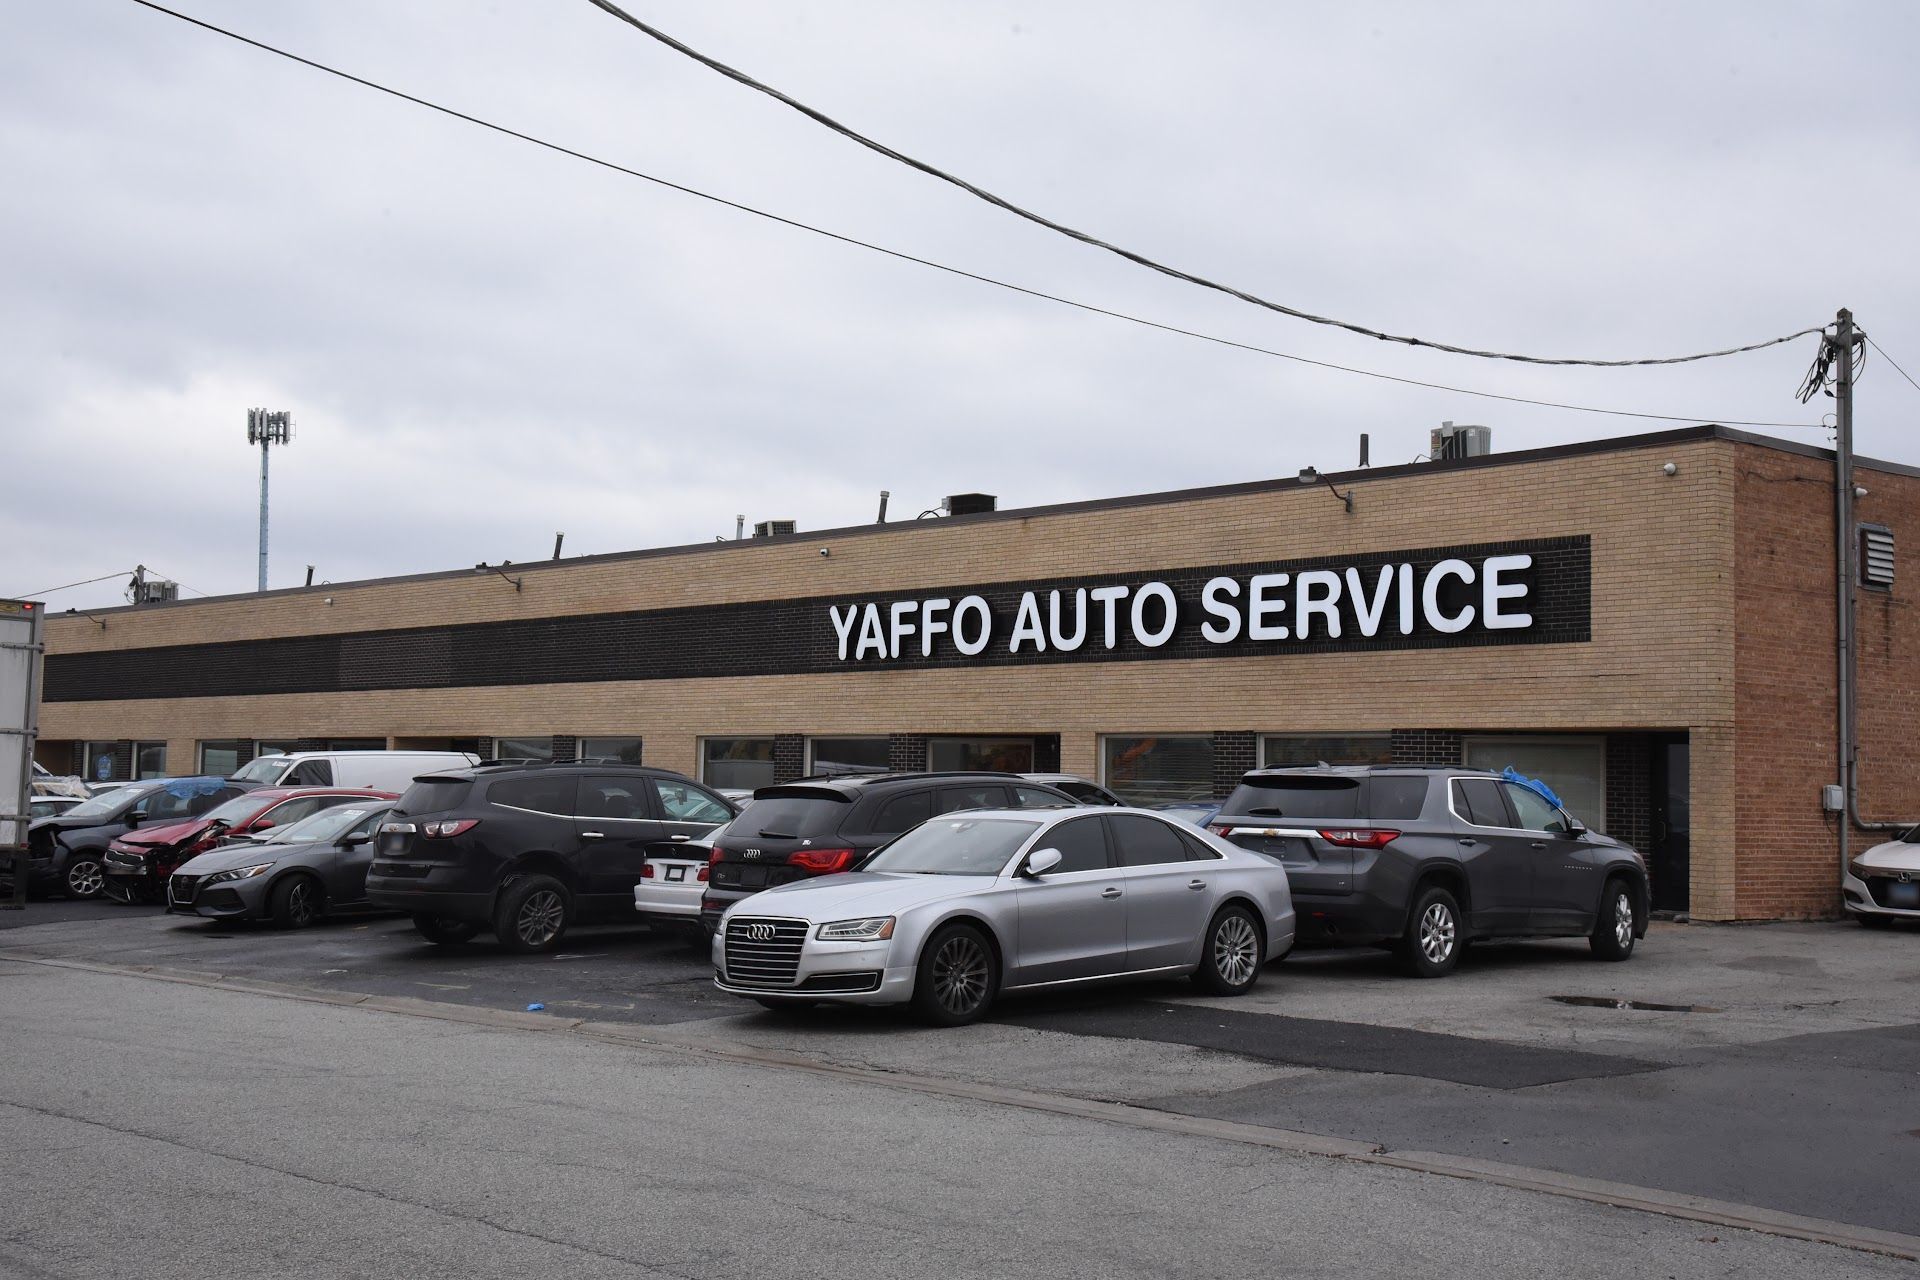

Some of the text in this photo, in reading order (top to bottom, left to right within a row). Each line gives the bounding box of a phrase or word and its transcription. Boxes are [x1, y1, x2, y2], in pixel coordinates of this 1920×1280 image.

[829, 554, 1533, 661] YAFFO AUTO SERVICE
